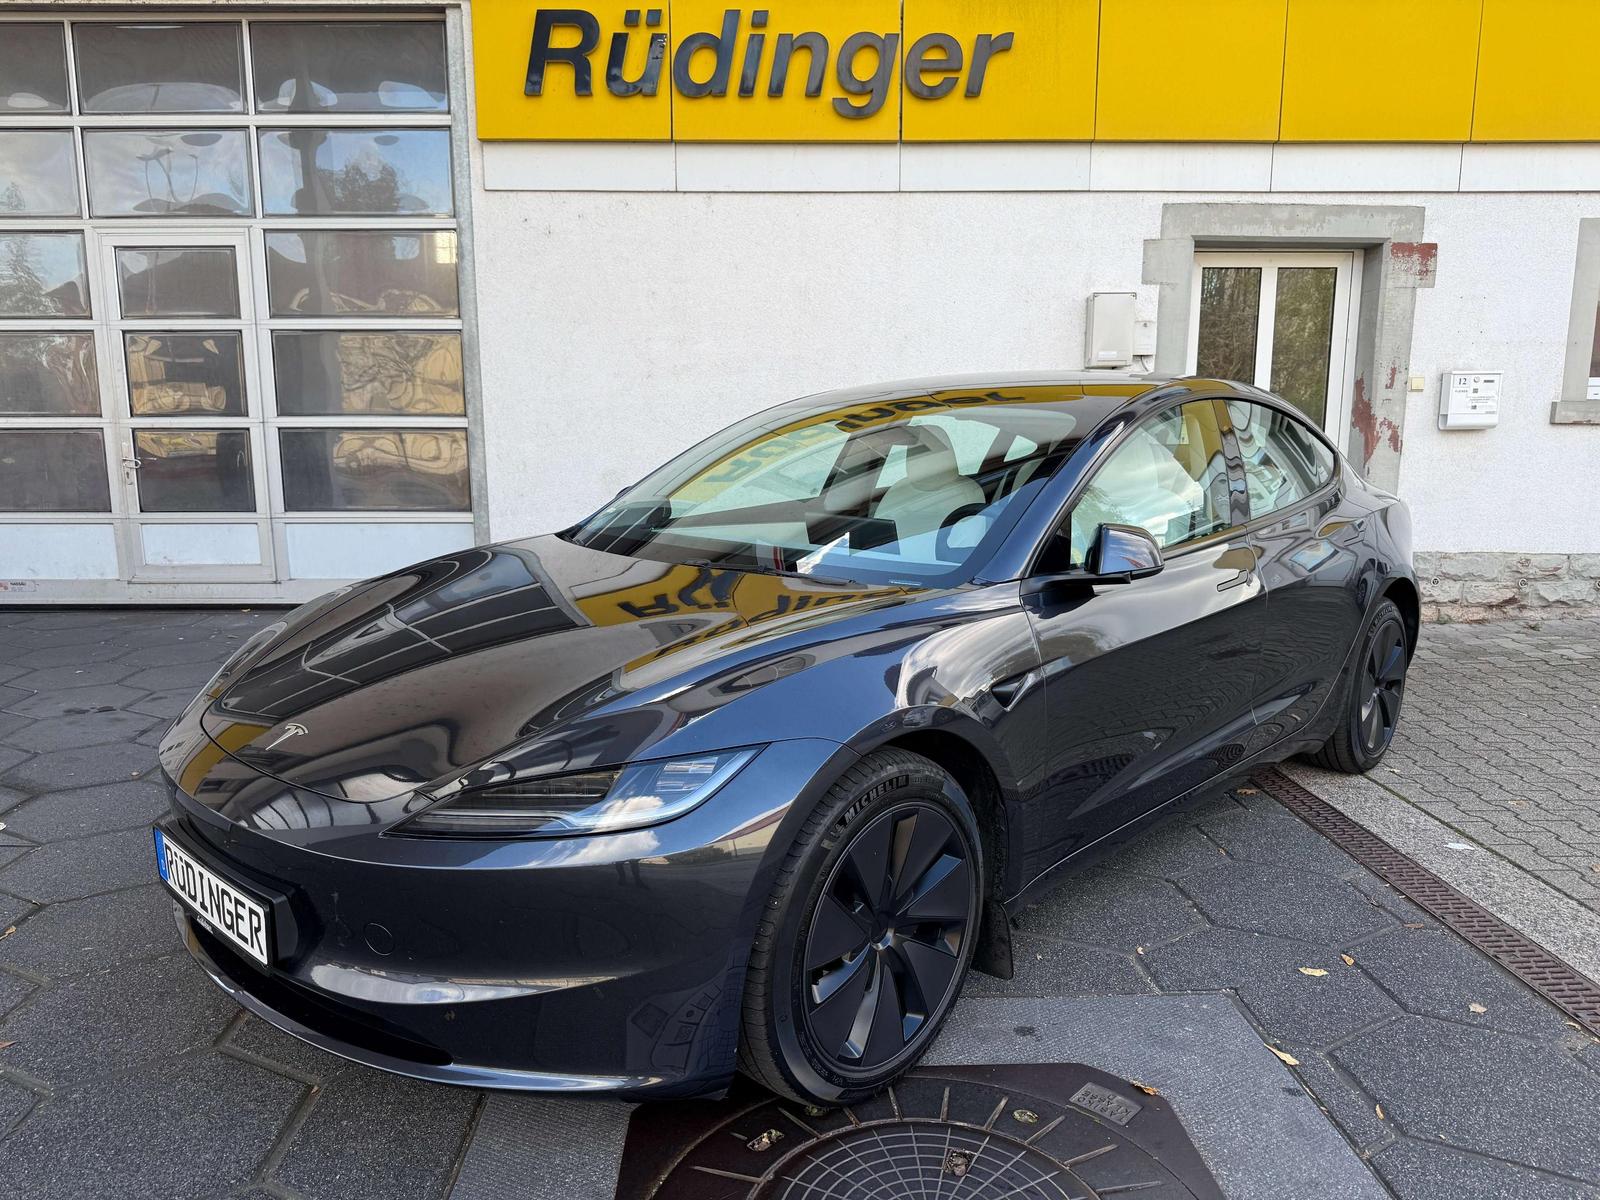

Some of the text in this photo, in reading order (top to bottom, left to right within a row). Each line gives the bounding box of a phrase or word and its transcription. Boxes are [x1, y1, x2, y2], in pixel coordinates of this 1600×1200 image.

[523, 9, 1015, 119] Rüdinger
[1458, 377, 1467, 386] 12
[844, 774, 909, 824] MICHELIN
[164, 843, 265, 957] RÜDINGER
